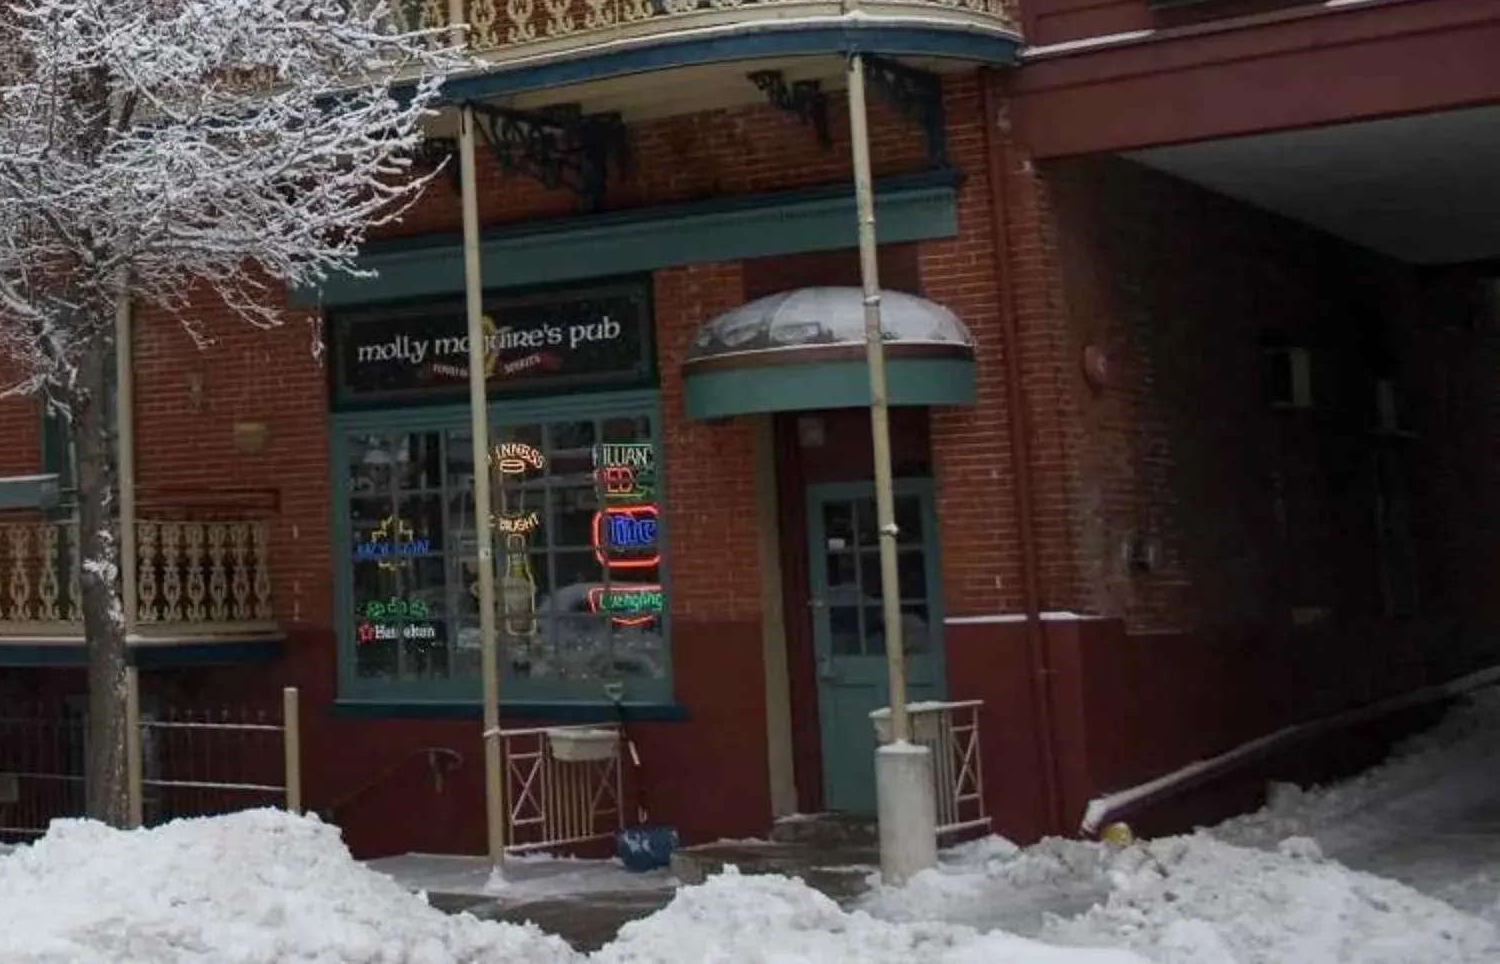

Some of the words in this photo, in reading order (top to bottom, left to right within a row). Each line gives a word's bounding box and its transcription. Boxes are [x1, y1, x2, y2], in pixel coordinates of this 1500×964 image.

[358, 336, 428, 364] molly
[435, 324, 562, 356] muire's
[569, 315, 621, 349] pub
[486, 443, 545, 469] INNESS
[374, 622, 436, 639] Heieken
